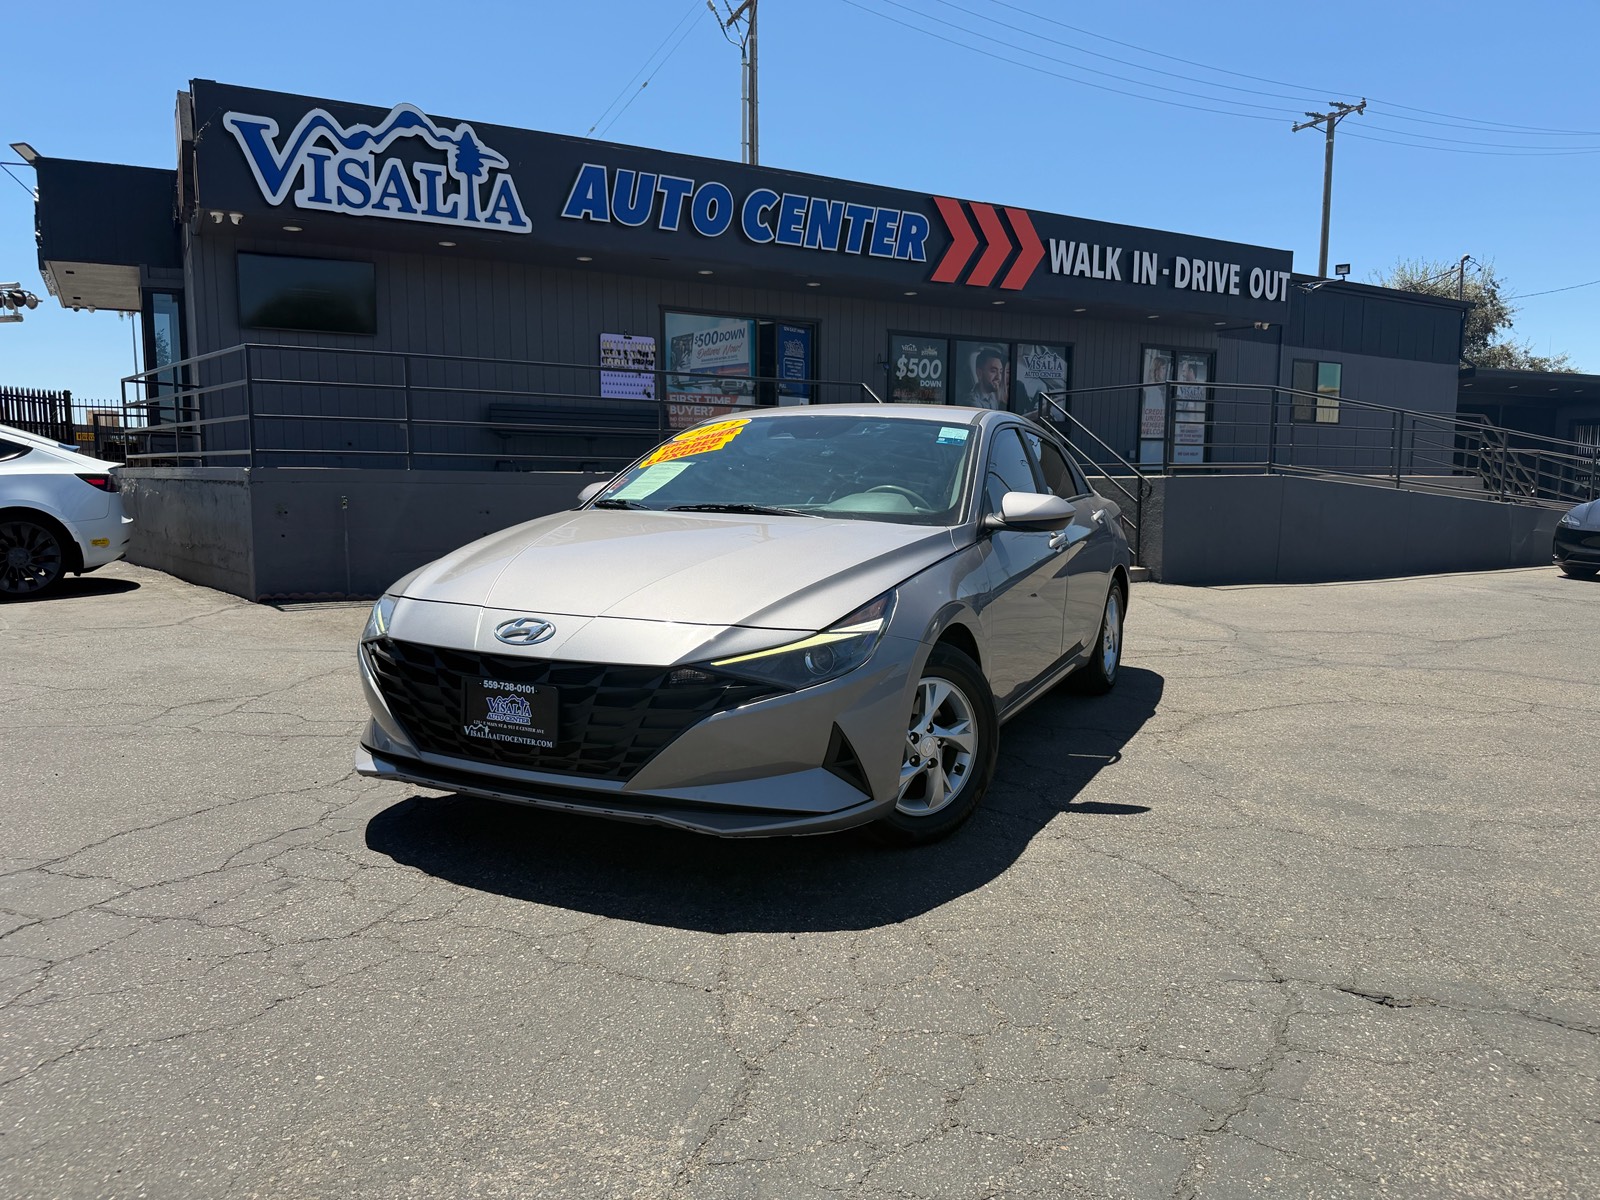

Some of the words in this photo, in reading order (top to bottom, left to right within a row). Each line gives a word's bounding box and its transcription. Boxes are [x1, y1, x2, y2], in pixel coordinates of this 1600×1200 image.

[223, 103, 532, 233] VISALIA
[561, 162, 734, 237] AUTO
[741, 188, 930, 262] CENTER
[1049, 238, 1122, 281] WALK
[1132, 250, 1158, 286] IN
[1174, 256, 1241, 296] DRIVE
[1249, 267, 1291, 302] OUT
[694, 331, 719, 348] $500
[719, 328, 746, 343] DOWN
[895, 354, 942, 380] $500
[1024, 352, 1063, 370] VISALIA
[920, 380, 942, 388] DOWN
[669, 394, 702, 403] FIRST
[704, 396, 731, 404] TIME
[669, 405, 714, 416] BUYER?
[646, 444, 720, 465] LUXURY
[662, 437, 722, 456] LOADED
[483, 679, 535, 694] 559-738-0101
[486, 695, 532, 717] VISALIA
[487, 712, 504, 721] AUTO
[504, 714, 531, 725] CENTER
